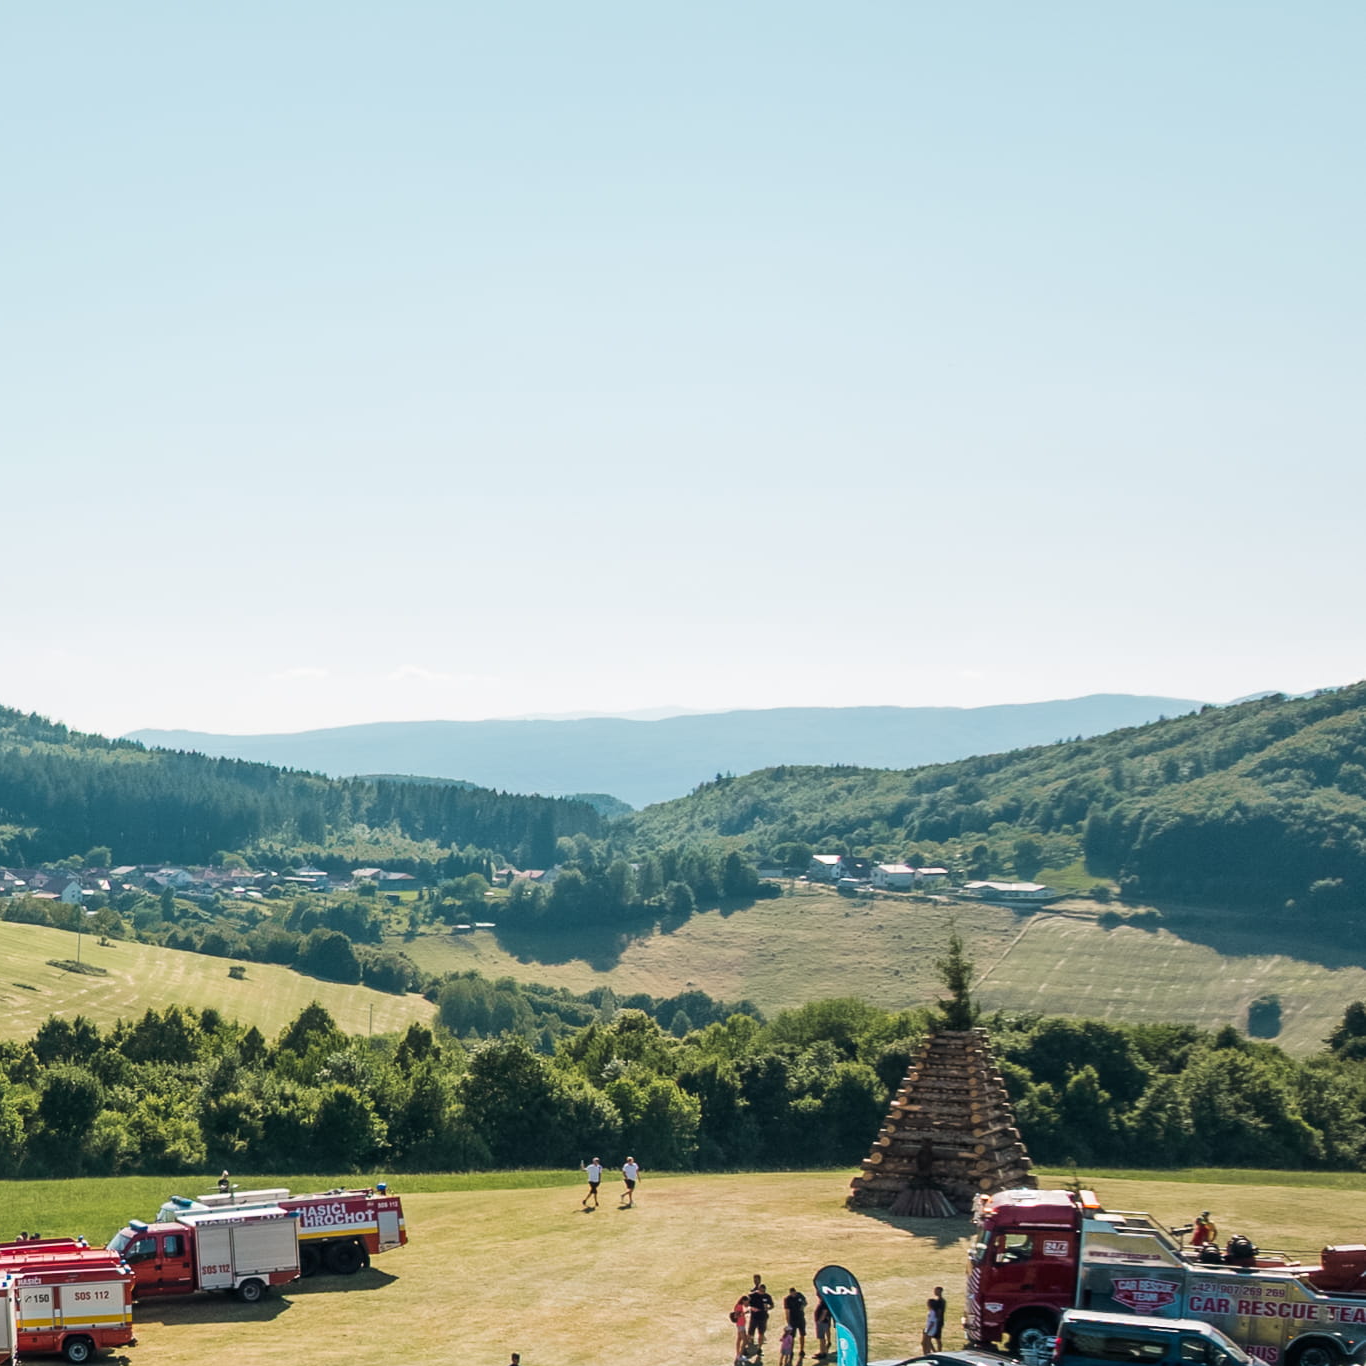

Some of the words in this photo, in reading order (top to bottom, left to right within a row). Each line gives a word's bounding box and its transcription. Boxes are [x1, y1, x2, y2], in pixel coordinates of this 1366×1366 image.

[296, 1202, 346, 1217] HASIČI
[202, 1265, 217, 1275] SOS
[219, 1264, 230, 1273] 112
[1118, 1280, 1137, 1290] CAR
[1139, 1280, 1174, 1291] RESCUE
[74, 1292, 91, 1301] SOS
[94, 1291, 109, 1300] 112
[1133, 1292, 1159, 1301] TEAM
[1220, 1285, 1239, 1295] 907
[1265, 1288, 1285, 1298] 269
[34, 1294, 49, 1303] 150
[1189, 1296, 1230, 1314] CAR
[1237, 1300, 1318, 1320] RESCUE
[1327, 1306, 1366, 1323] TEA
